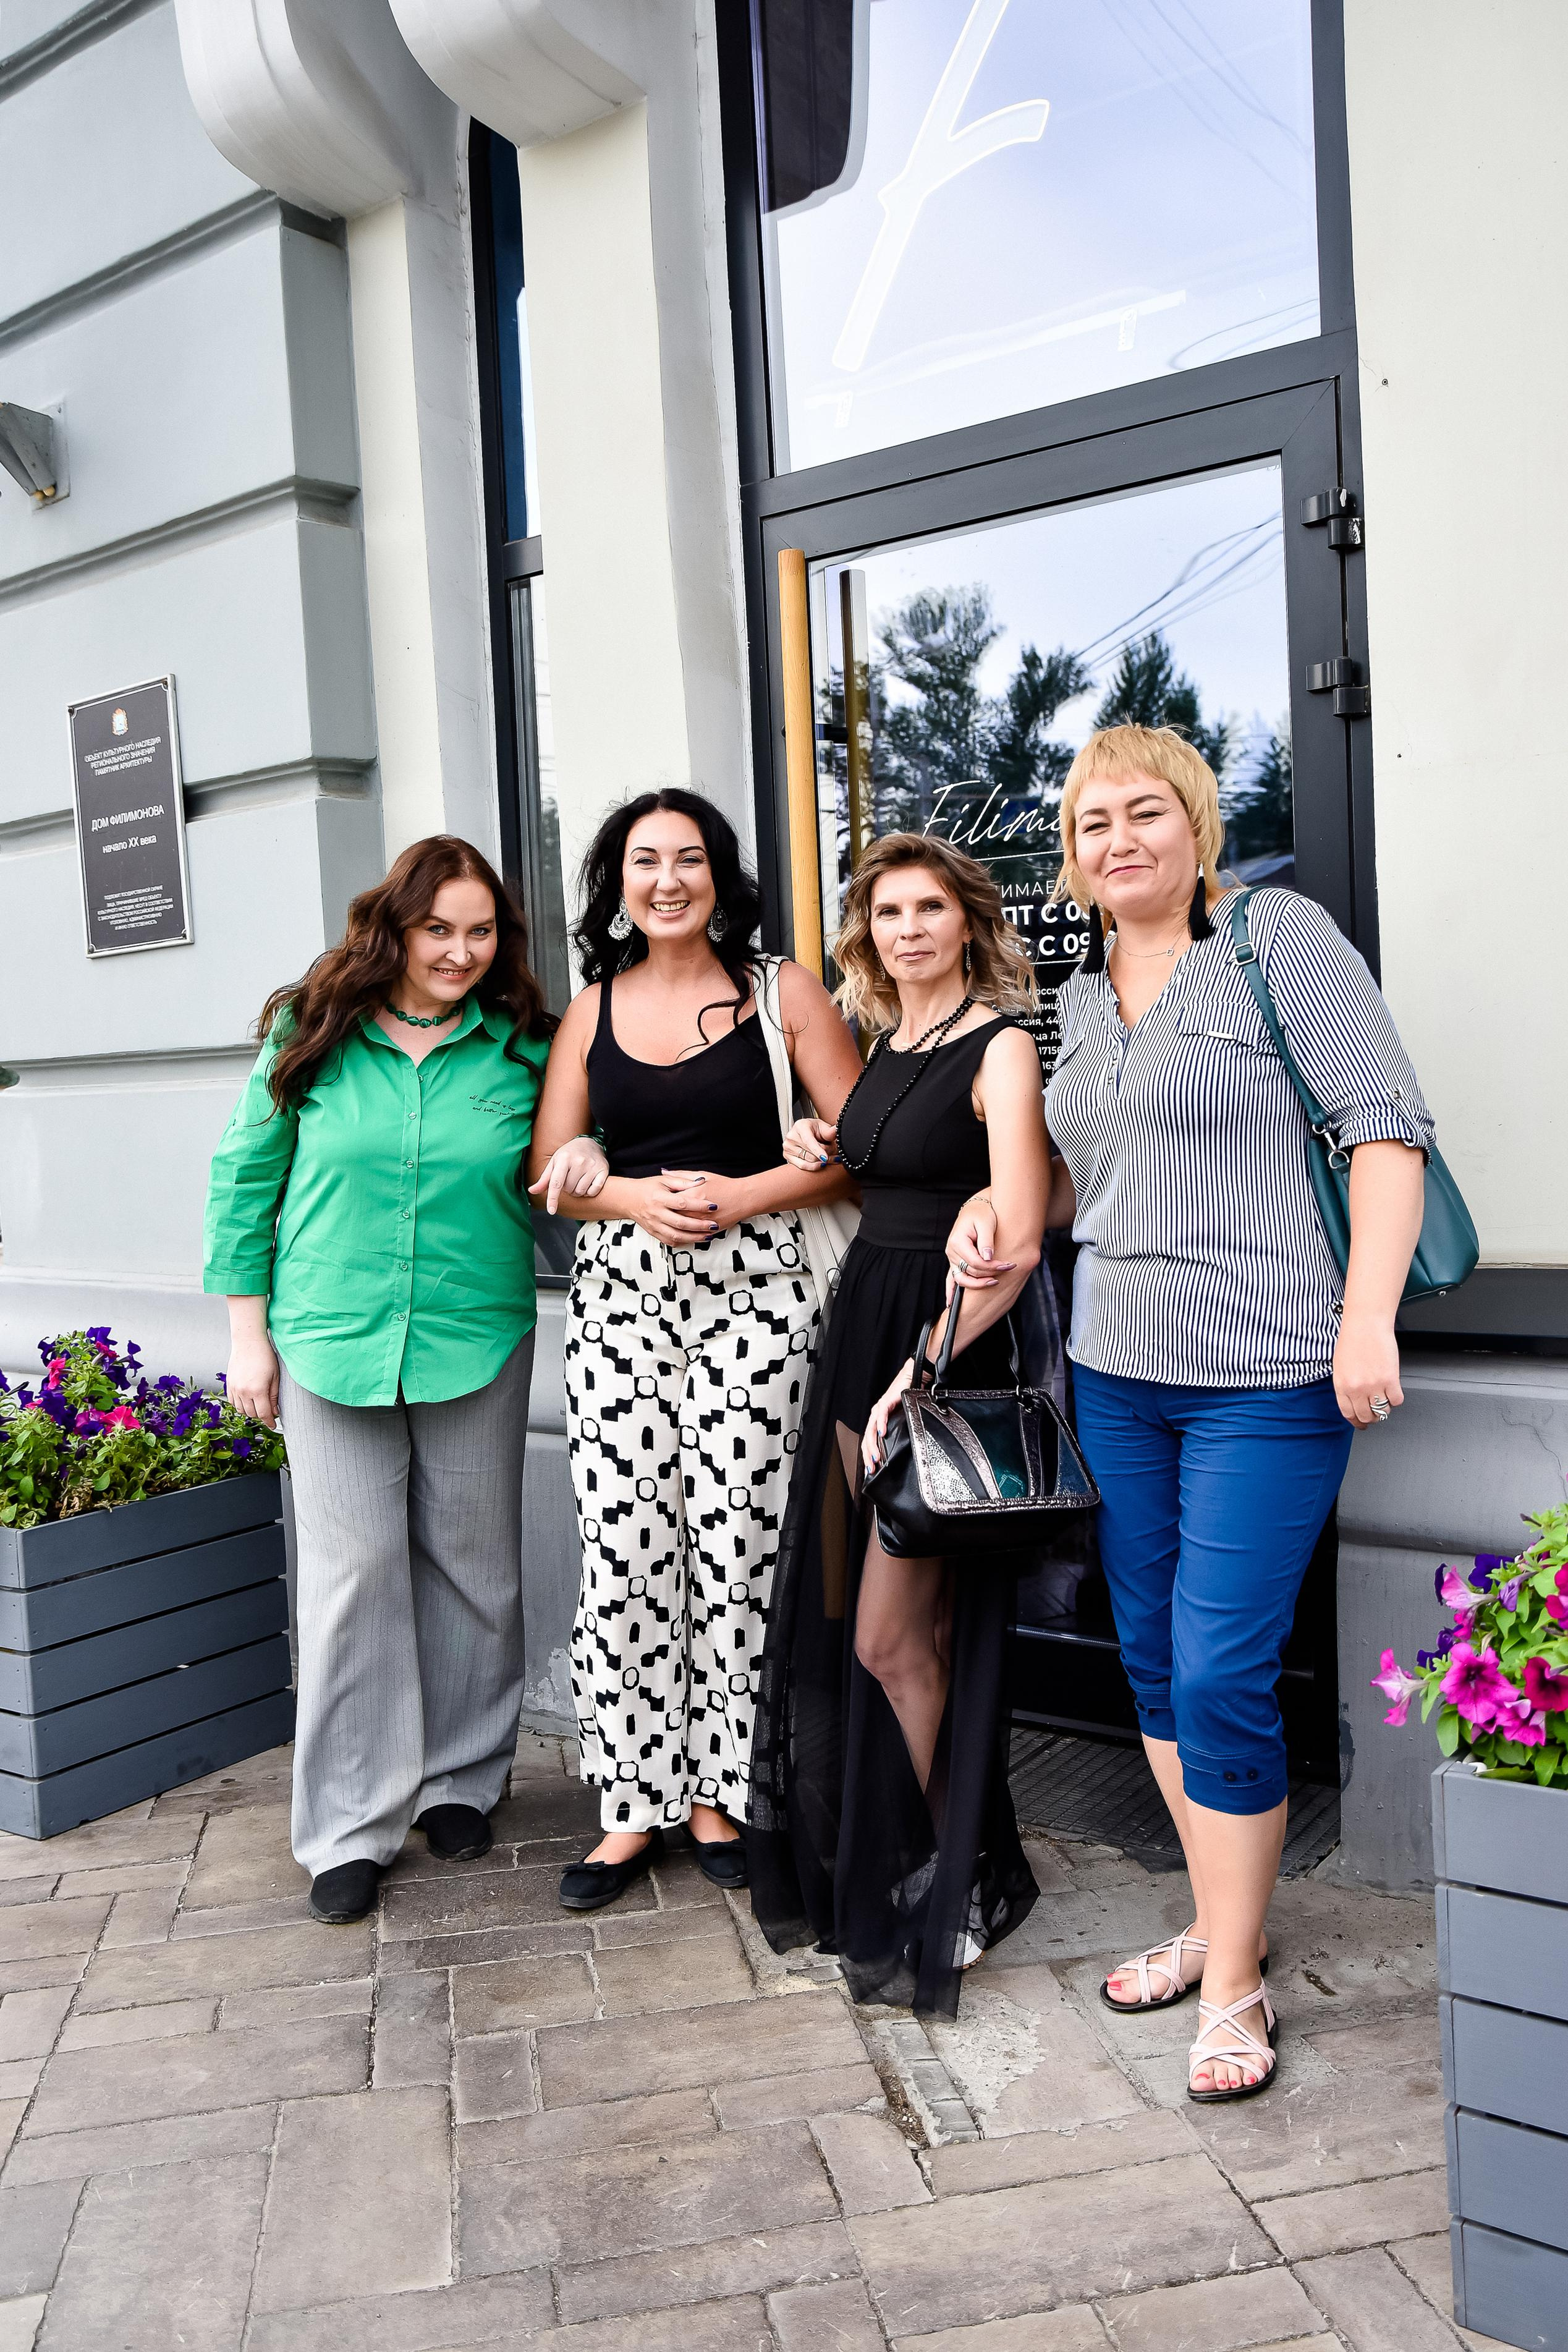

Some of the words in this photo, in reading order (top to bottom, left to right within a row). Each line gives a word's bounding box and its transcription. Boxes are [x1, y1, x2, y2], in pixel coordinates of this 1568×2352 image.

[85, 752, 103, 763] ОБЪЕКТ
[103, 744, 135, 758] КУЛЬТУРНОГО
[135, 736, 161, 749] НАСЛЕДИЯ
[90, 754, 130, 769] РЕГИОНАЛЬНОГО
[130, 746, 156, 758] ЗНАЧЕНИЯ
[95, 764, 119, 776] ПАМЯТНИК
[120, 756, 153, 770] АРХИТЕКТУРЫ
[91, 815, 109, 832] ДОМ
[109, 804, 165, 826] ФИЛИМОНОВА
[102, 841, 127, 854] начало
[140, 834, 157, 846] века
[1001, 878, 1067, 898] ИМАЕТ
[1041, 902, 1058, 923] С
[1039, 935, 1056, 956] С
[1063, 932, 1090, 954] 09
[1029, 988, 1058, 996] осси
[1033, 1003, 1057, 1013] улиц
[1015, 1019, 1043, 1027] ссия,
[1046, 1016, 1058, 1024] 44
[1033, 1033, 1048, 1042] ца
[1050, 1031, 1062, 1040] Ле
